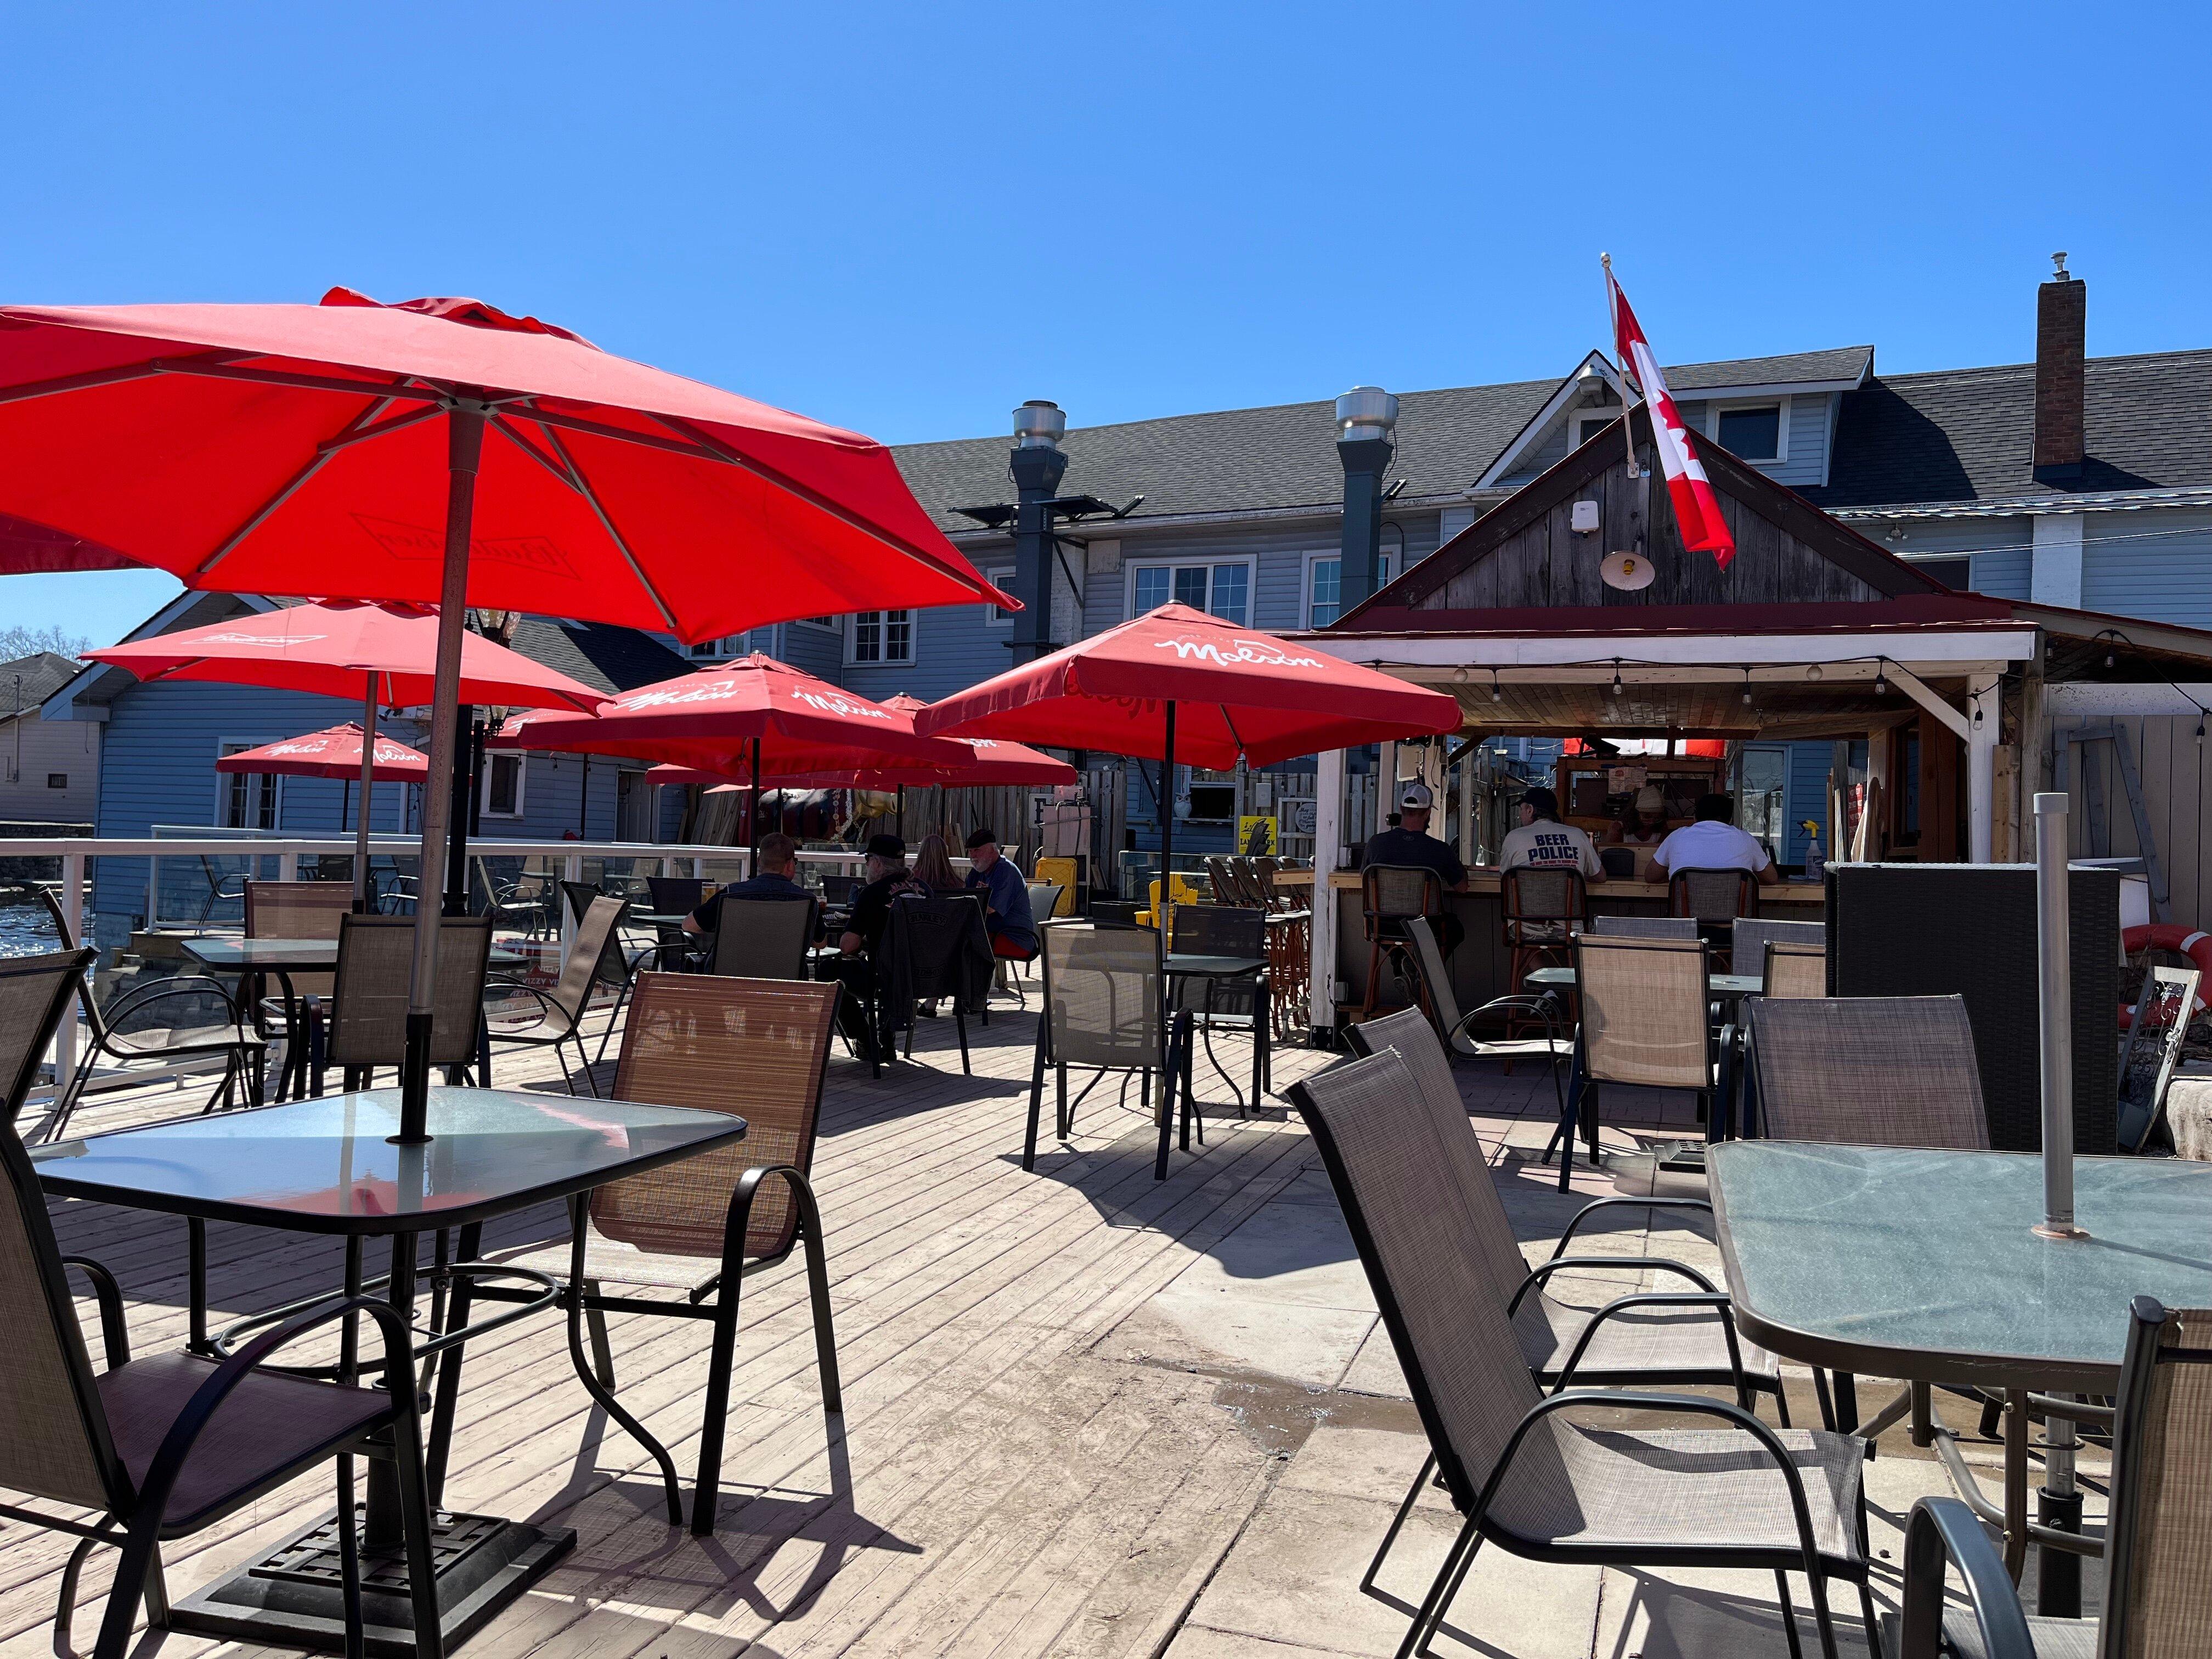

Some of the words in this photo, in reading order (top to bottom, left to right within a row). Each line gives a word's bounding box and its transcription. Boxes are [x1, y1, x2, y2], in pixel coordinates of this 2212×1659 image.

[1154, 640, 1324, 667] Molson
[613, 689, 738, 712] Molson
[791, 691, 892, 720] Molson
[264, 744, 326, 757] Molson
[1534, 834, 1570, 846] BEER
[1527, 846, 1579, 862] POLICE
